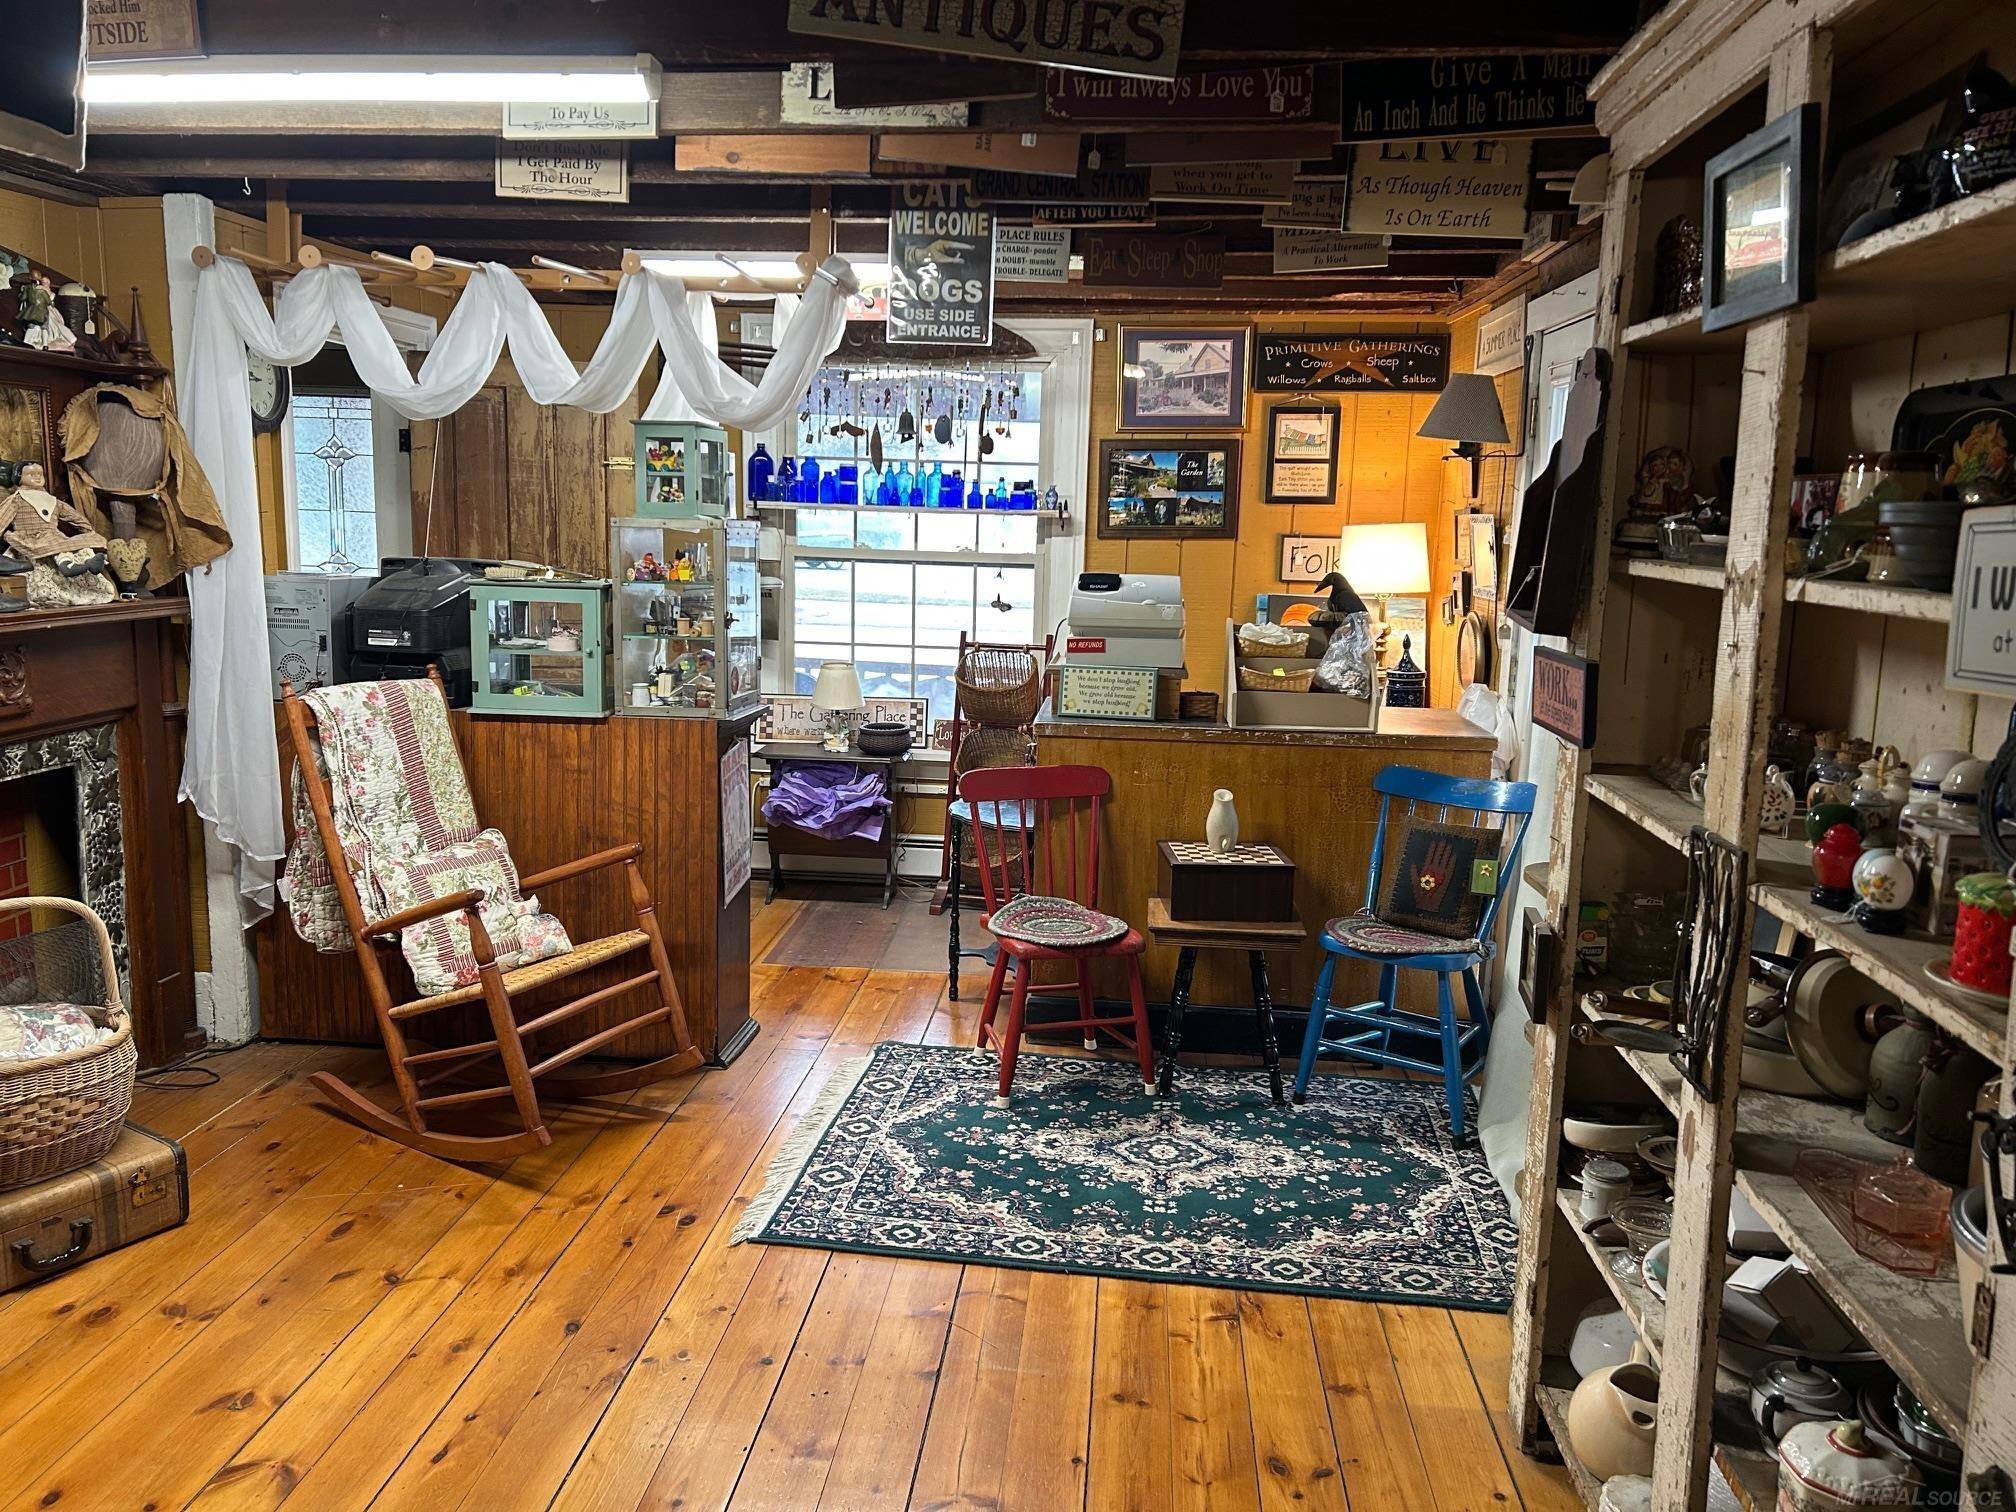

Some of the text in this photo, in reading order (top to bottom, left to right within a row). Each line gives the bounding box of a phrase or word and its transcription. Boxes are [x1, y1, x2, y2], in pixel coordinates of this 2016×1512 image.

[120, 0, 142, 13] Him
[1430, 53, 1592, 89] Give A Man
[1074, 76, 1114, 98] will
[1120, 75, 1192, 105] always
[1198, 73, 1254, 98] Love
[1262, 67, 1304, 98] You
[551, 107, 610, 122] To Pay Us
[1353, 101, 1374, 133] An
[1383, 98, 1421, 132] Inch
[1428, 96, 1459, 128] And
[1466, 94, 1487, 125] He
[1496, 88, 1555, 122] Thinks
[517, 156, 601, 174] I Get Paid By
[530, 170, 593, 186] The Hour
[1091, 172, 1149, 198] STATION
[1175, 182, 1206, 194] Work
[1356, 174, 1523, 202] As Though Heaven
[1037, 204, 1150, 220] AFTER YOU LEAVE
[1385, 207, 1493, 228] Is On Earth
[896, 210, 989, 237] WELCOME
[1000, 229, 1065, 242] PLACE RULES
[1033, 247, 1058, 256] ponder
[1290, 245, 1329, 256] Practical
[1330, 241, 1380, 253] Alternative
[1029, 258, 1057, 266] mumble
[1088, 236, 1223, 281] Eat Sleep Shop
[1313, 254, 1348, 265] To Work
[1029, 268, 1064, 277] DELEGATE
[901, 279, 984, 304] DOGS
[904, 308, 976, 323] USE SIDE
[898, 323, 982, 339] ENTRANCE
[1264, 338, 1441, 361] PRIMITIVE GATHERINGS
[1300, 354, 1400, 371] Crows Sheep
[1267, 374, 1307, 385] Willows
[1334, 374, 1372, 386] Ragballs
[1186, 460, 1199, 468] The
[1290, 545, 1341, 574] Folk
[1068, 641, 1104, 649] NO REFUNDS
[1992, 628, 2014, 654] at
[1077, 674, 1086, 682] We
[1103, 677, 1116, 685] stop
[1116, 677, 1141, 688] laughing
[1079, 682, 1100, 690] because
[1088, 690, 1102, 698] grow
[1092, 698, 1105, 707] stop
[777, 703, 907, 723] The Gatering Place
